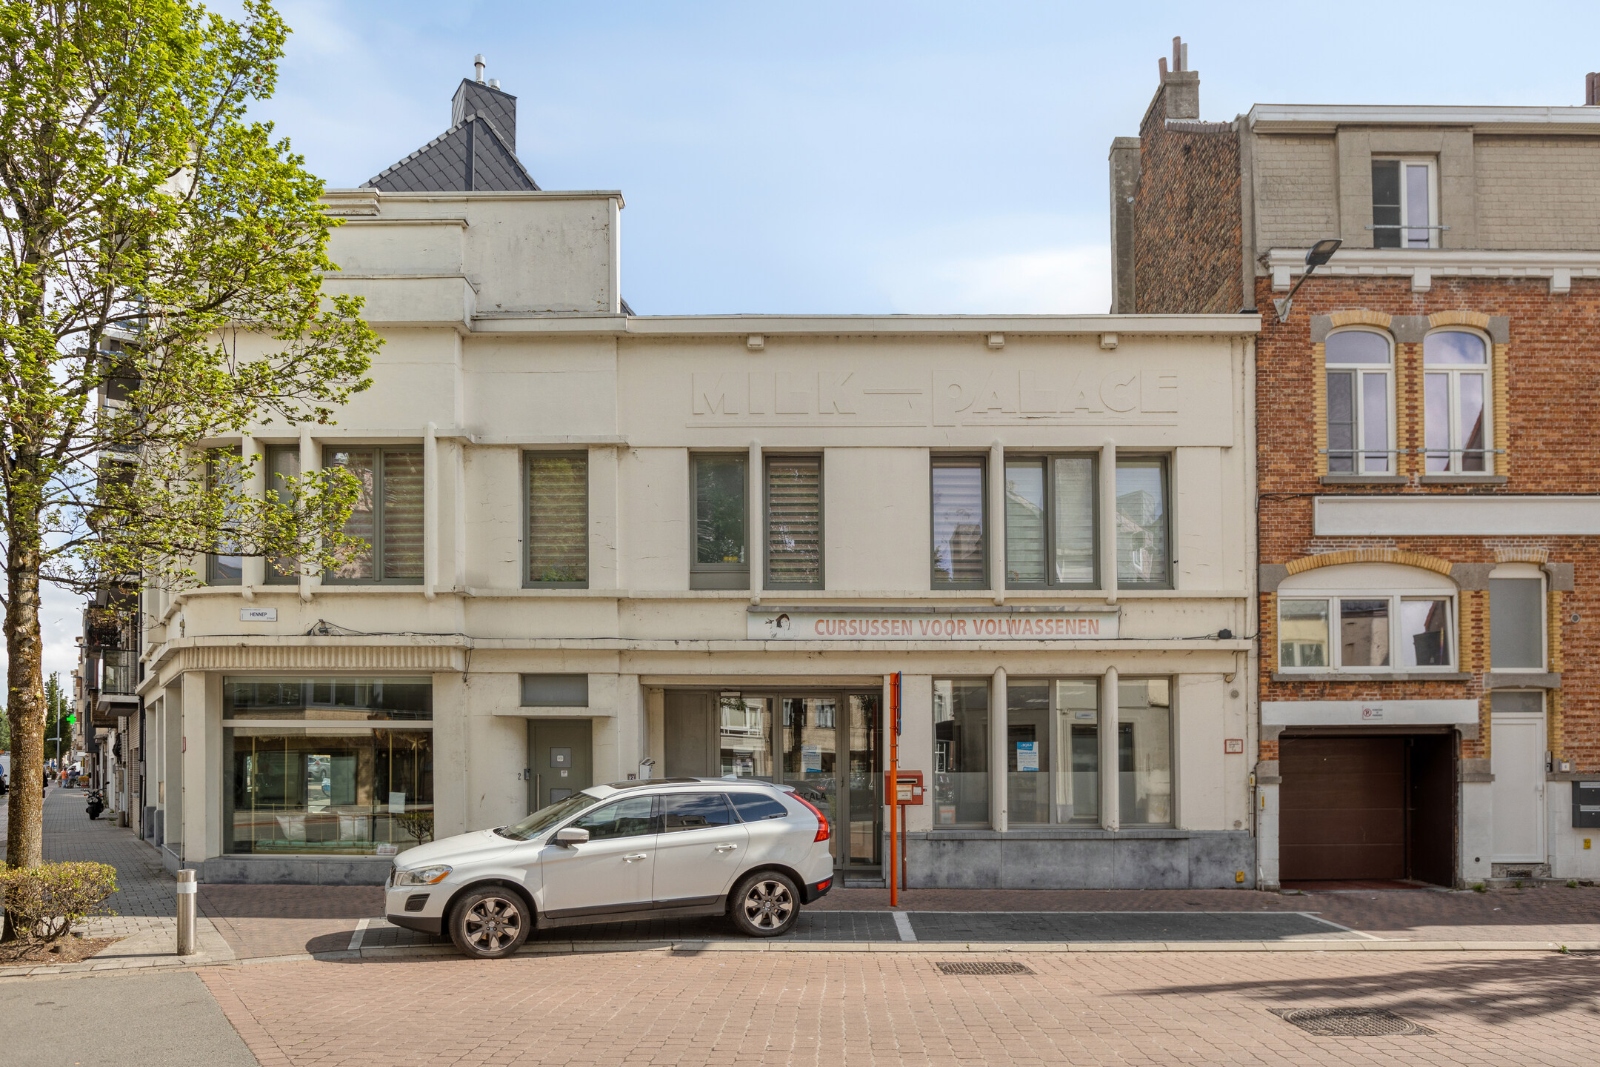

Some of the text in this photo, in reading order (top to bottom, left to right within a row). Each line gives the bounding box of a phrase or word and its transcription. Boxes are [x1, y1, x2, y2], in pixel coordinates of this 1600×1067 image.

[814, 618, 1100, 636] CURSUSSEN VOOR VOLWASSENEN
